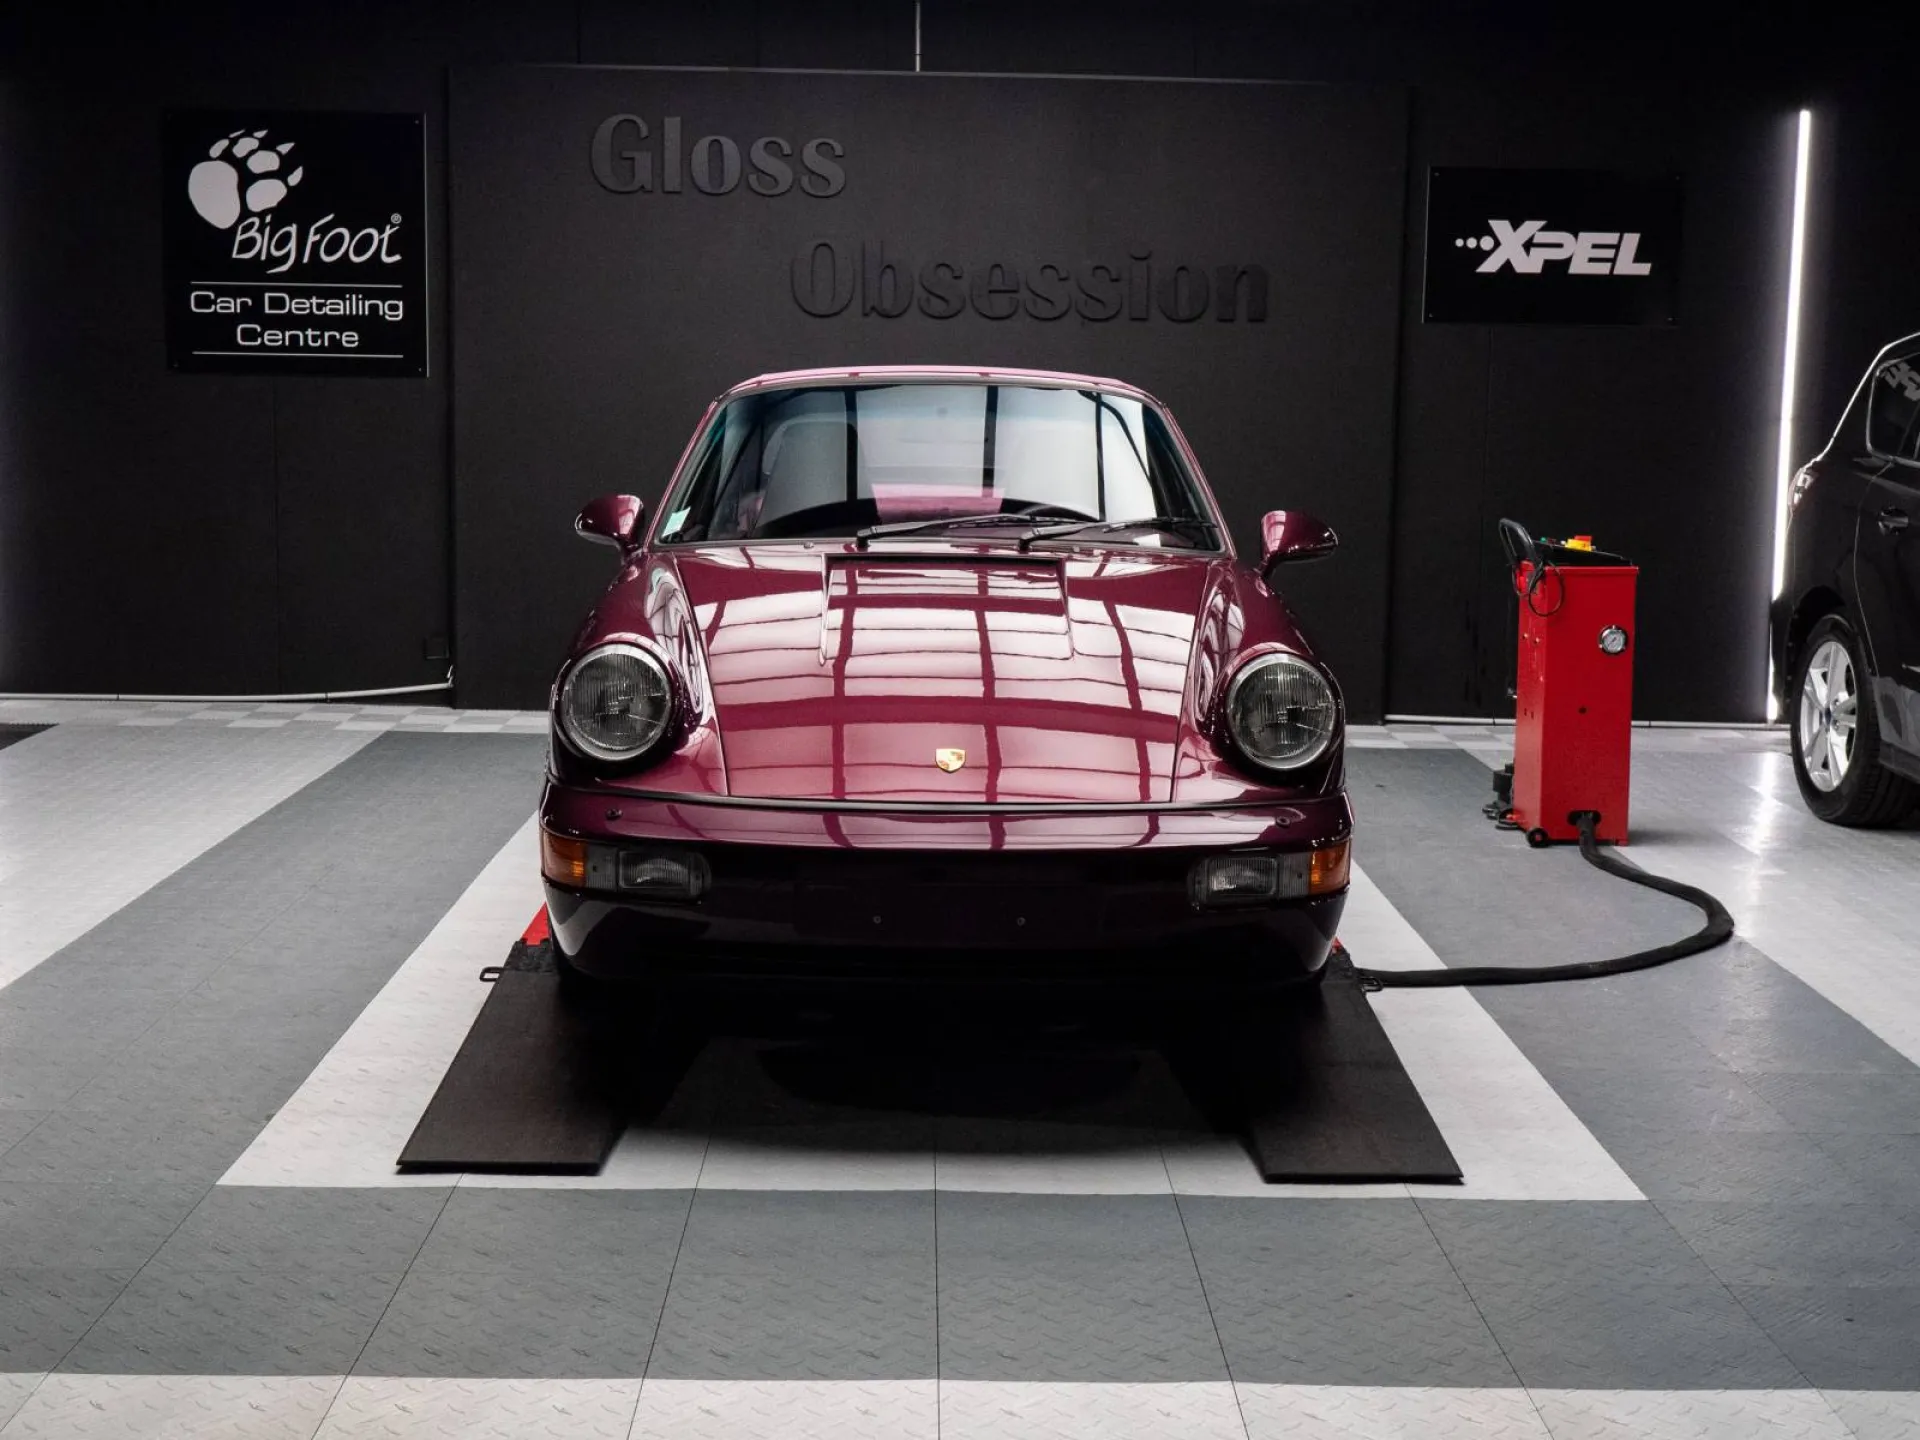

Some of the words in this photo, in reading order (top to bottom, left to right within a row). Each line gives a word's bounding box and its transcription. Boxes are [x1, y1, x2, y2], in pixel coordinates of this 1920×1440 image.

[590, 112, 847, 198] Gloss
[1475, 218, 1652, 276] XPEL
[190, 290, 253, 313] Car
[264, 292, 404, 321] Detailing
[789, 240, 1270, 324] Obsession
[236, 323, 360, 348] Centre
